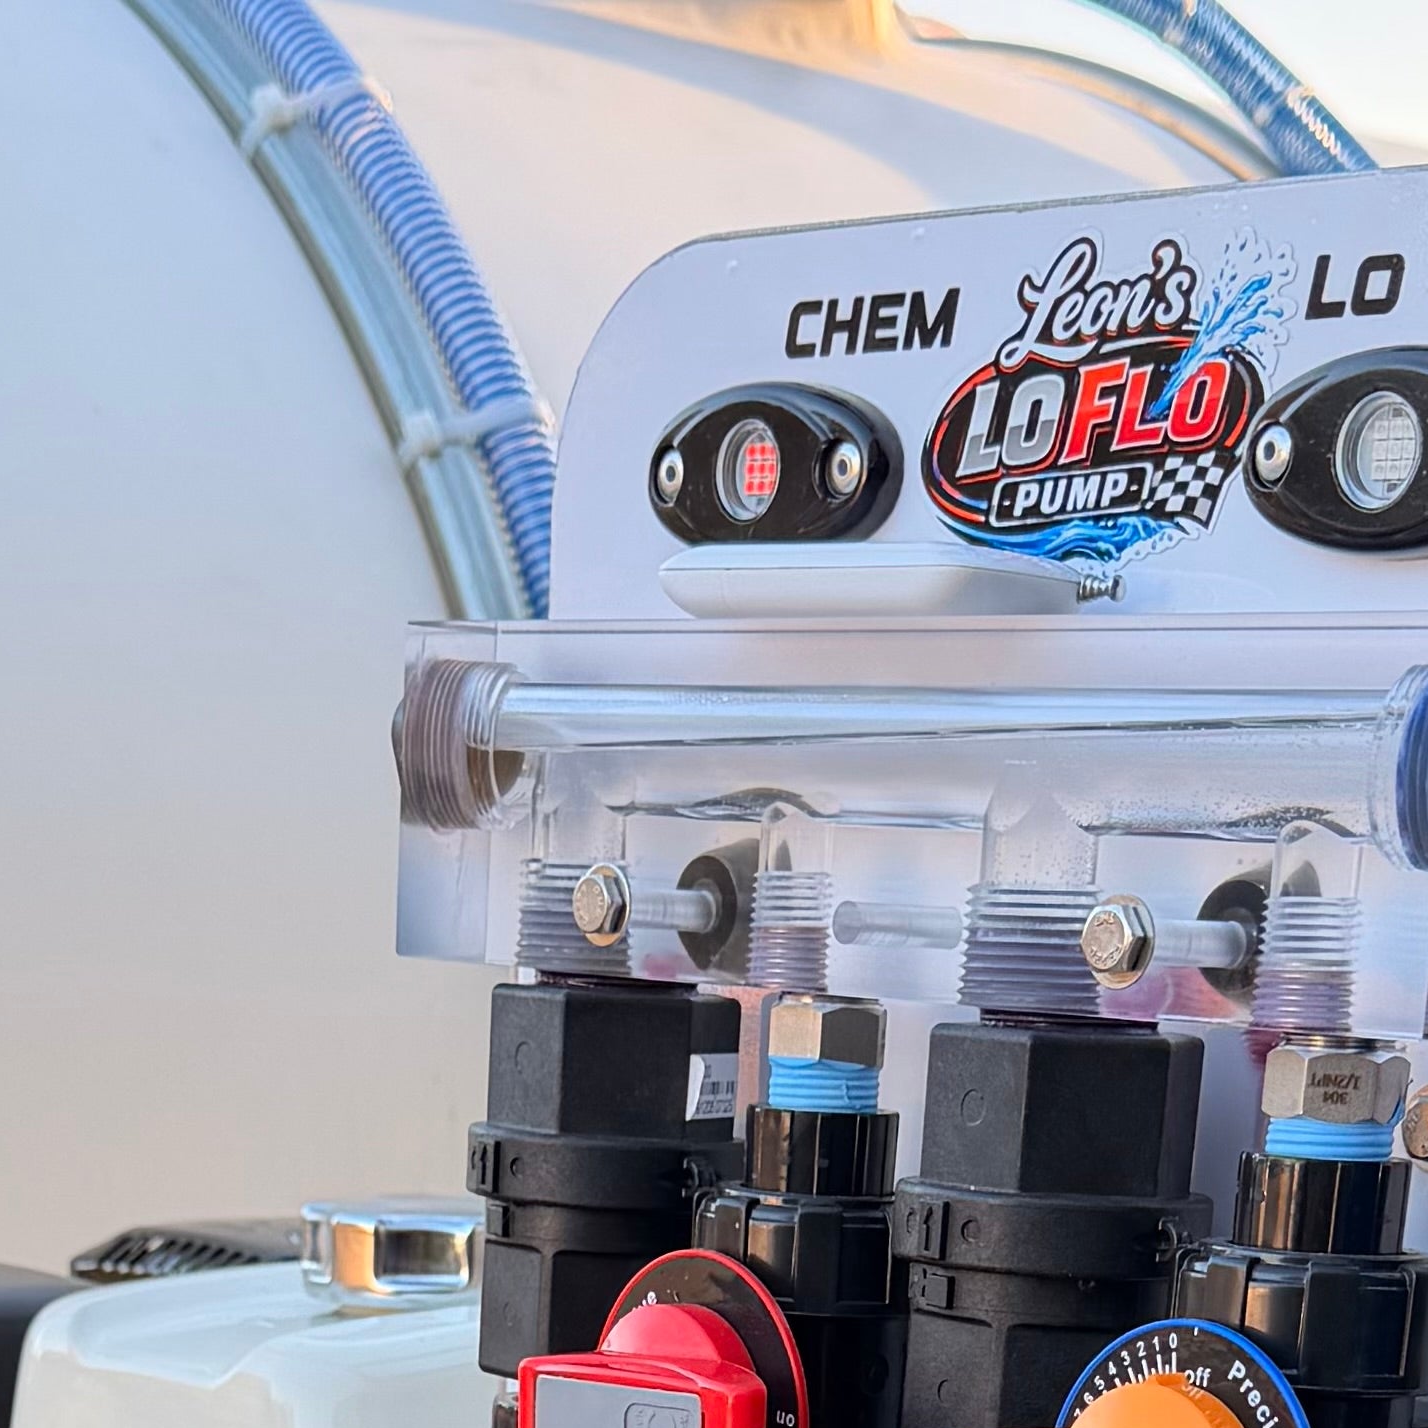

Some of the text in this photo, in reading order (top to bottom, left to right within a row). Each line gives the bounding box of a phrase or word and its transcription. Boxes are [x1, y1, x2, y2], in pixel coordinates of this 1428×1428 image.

[1305, 253, 1406, 320] LO
[998, 238, 1196, 368] Leon's
[785, 287, 961, 359] CHEM
[1012, 472, 1129, 518] PUMP
[1136, 1341, 1147, 1357] 2
[1152, 1335, 1160, 1352] 1
[1168, 1332, 1178, 1349] 0
[1120, 1350, 1131, 1366] 3
[1108, 1361, 1117, 1375] 4
[1094, 1375, 1105, 1390] 5
